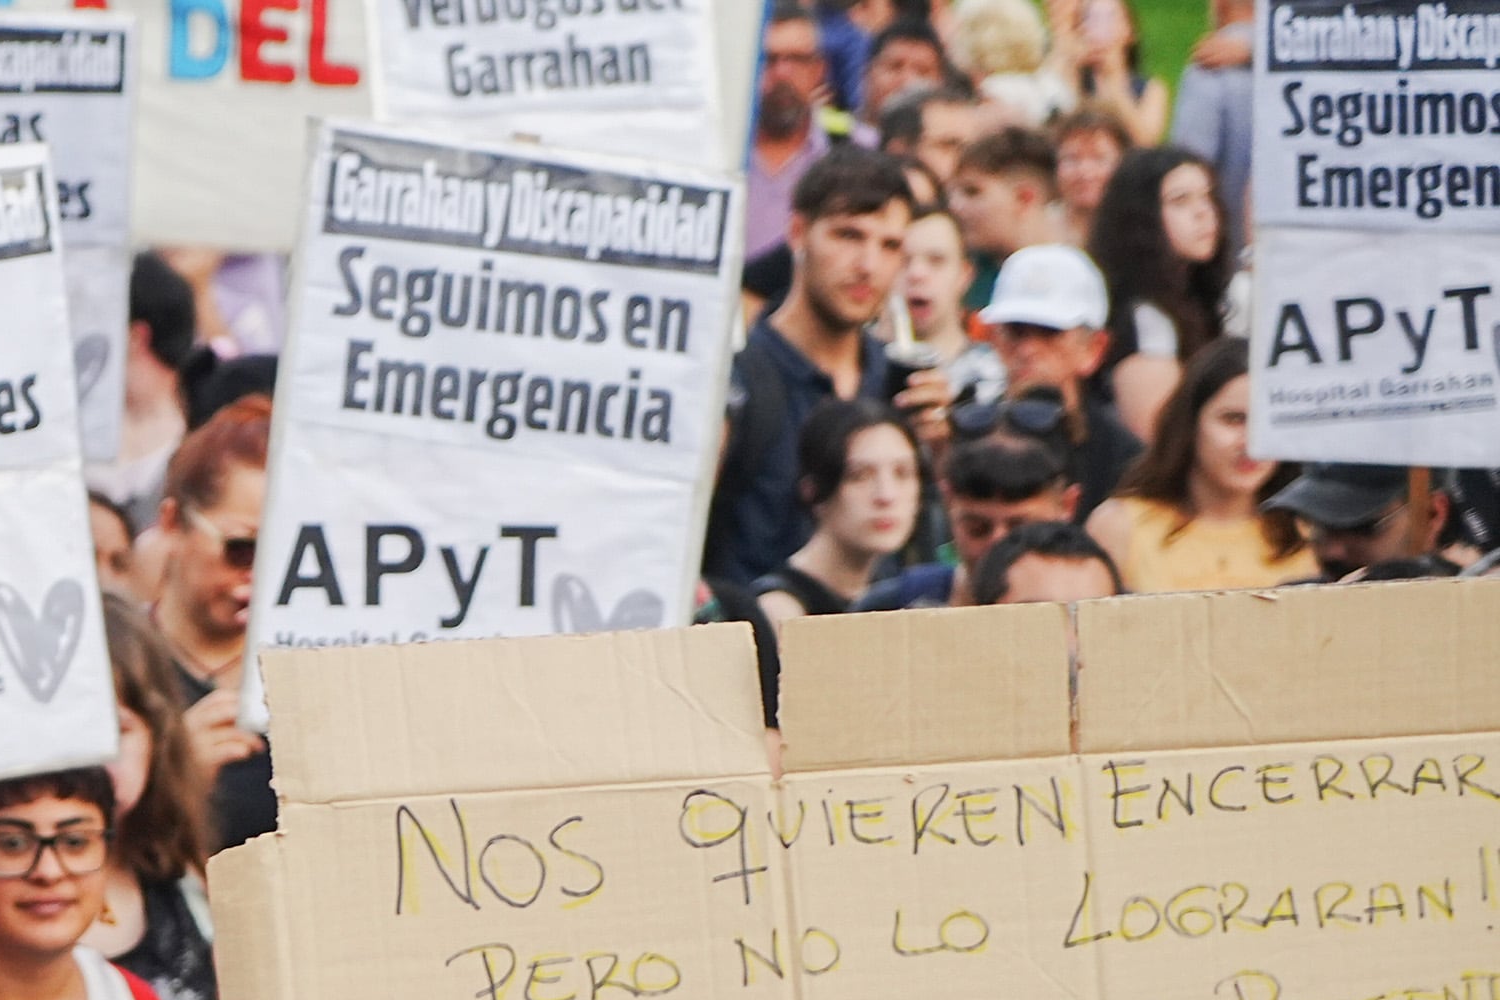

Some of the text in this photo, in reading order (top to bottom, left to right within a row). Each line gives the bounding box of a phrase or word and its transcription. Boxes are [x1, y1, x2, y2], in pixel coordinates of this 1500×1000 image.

[168, 0, 360, 85] DEL
[445, 34, 653, 97] Garrahan
[1274, 3, 1397, 63] Garrahan
[1396, 14, 1416, 70] y
[332, 150, 723, 262] Garrahan y Discapacidad
[332, 245, 691, 354] Seguimos en
[1266, 285, 1493, 375] APyT
[341, 340, 673, 445] Emergencia
[275, 524, 560, 630] APyT
[394, 752, 1500, 916] NOS QUIEREN ENCERRAR
[733, 926, 841, 988] NO
[891, 908, 990, 957] LO
